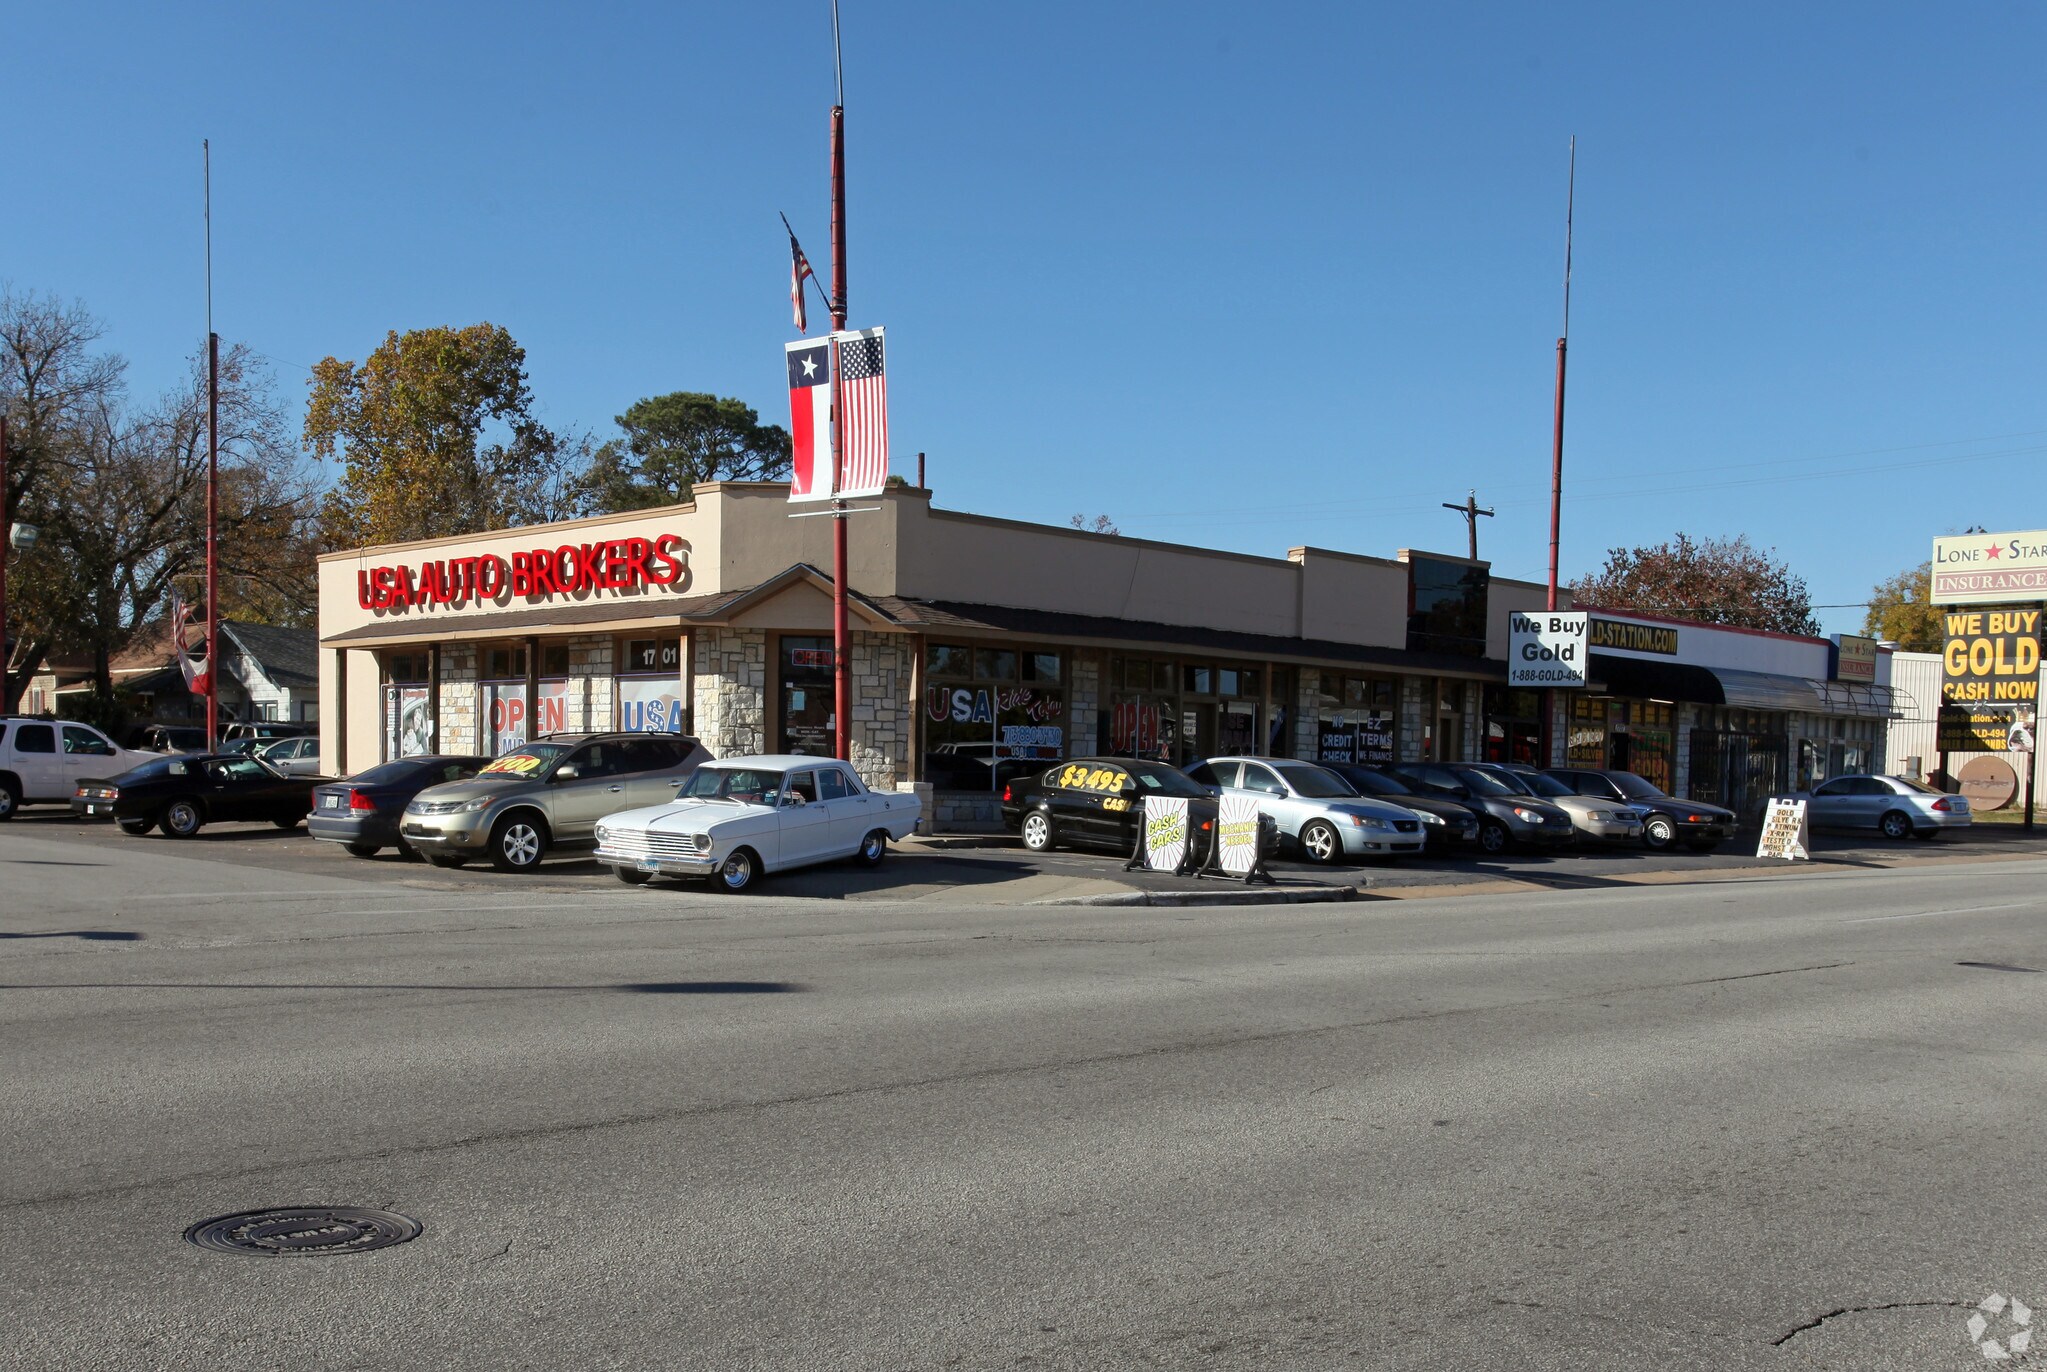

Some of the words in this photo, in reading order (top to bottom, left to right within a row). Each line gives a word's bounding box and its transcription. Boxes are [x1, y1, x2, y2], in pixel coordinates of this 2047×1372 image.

[1937, 545, 1980, 563] LONE
[2009, 540, 2047, 559] STAR
[358, 564, 413, 610] USA
[416, 553, 504, 604] AUTO
[512, 533, 682, 597] BROKERS
[1938, 572, 2047, 592] INSURANCE
[1512, 618, 1542, 633] We
[1549, 618, 1586, 637] Buy
[1947, 615, 1982, 636] WE
[1989, 612, 2039, 634] BUY
[795, 651, 832, 665] OPEN
[1521, 643, 1575, 662] Gold
[1944, 637, 2040, 676] GOLD
[1511, 670, 1583, 682] 1-888-GOLD-494
[1944, 683, 1990, 700] CASH
[1995, 681, 2038, 699] NOW
[489, 696, 564, 734] OPEN
[927, 687, 993, 724] USA
[1113, 703, 1159, 752] OPEN
[1332, 715, 1344, 728] NO
[1367, 718, 1381, 730] EZ
[1322, 734, 1353, 748] CREDIT
[1360, 733, 1393, 746] TERMS
[1322, 751, 1351, 763] CHECK
[1359, 750, 1367, 761] WE
[1368, 751, 1393, 762] FINANCE
[1060, 764, 1128, 793] $3,495
[1777, 809, 1794, 817] GOLD
[1148, 811, 1179, 836] CASH
[1219, 821, 1259, 836] MECHANIC
[1149, 825, 1186, 851] CARS!
[1225, 836, 1253, 847] NEEDED
